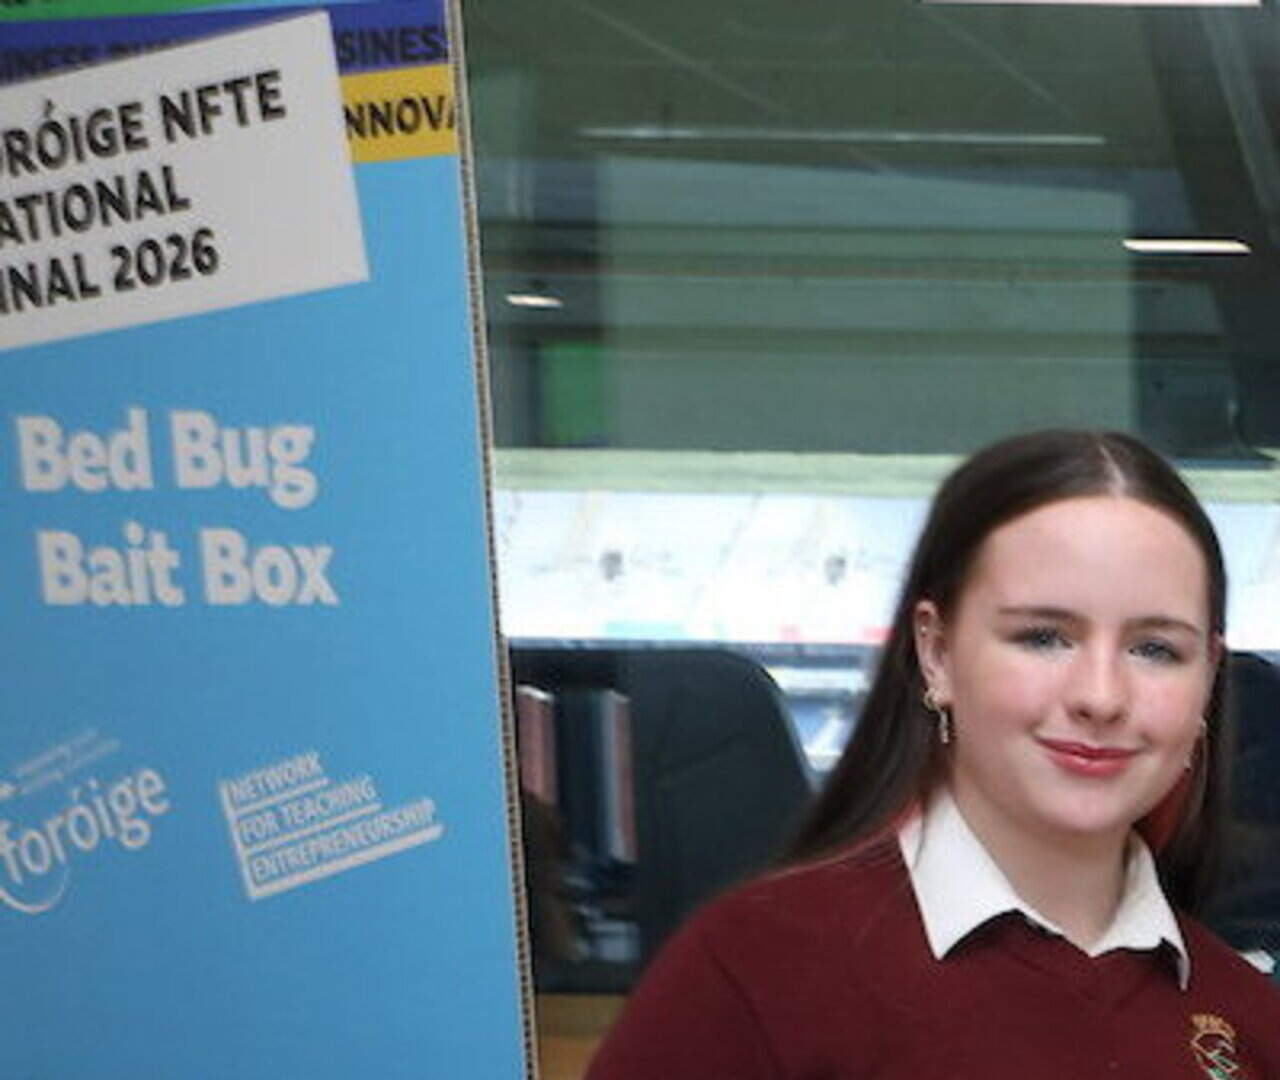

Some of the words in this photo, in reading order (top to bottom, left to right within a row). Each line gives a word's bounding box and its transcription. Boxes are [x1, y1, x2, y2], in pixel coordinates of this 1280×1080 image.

[0, 100, 149, 177] RÓIGE
[159, 69, 287, 144] NFTE
[111, 226, 220, 293] 2026
[16, 408, 154, 492] Bed
[169, 409, 319, 509] Bug
[36, 520, 187, 607] Bait
[199, 526, 340, 607] Box
[229, 751, 324, 801] NETWORK
[239, 810, 279, 844] FOR
[282, 774, 378, 833] TEACHING
[251, 796, 438, 883] ENTREPRENEURSHIP
